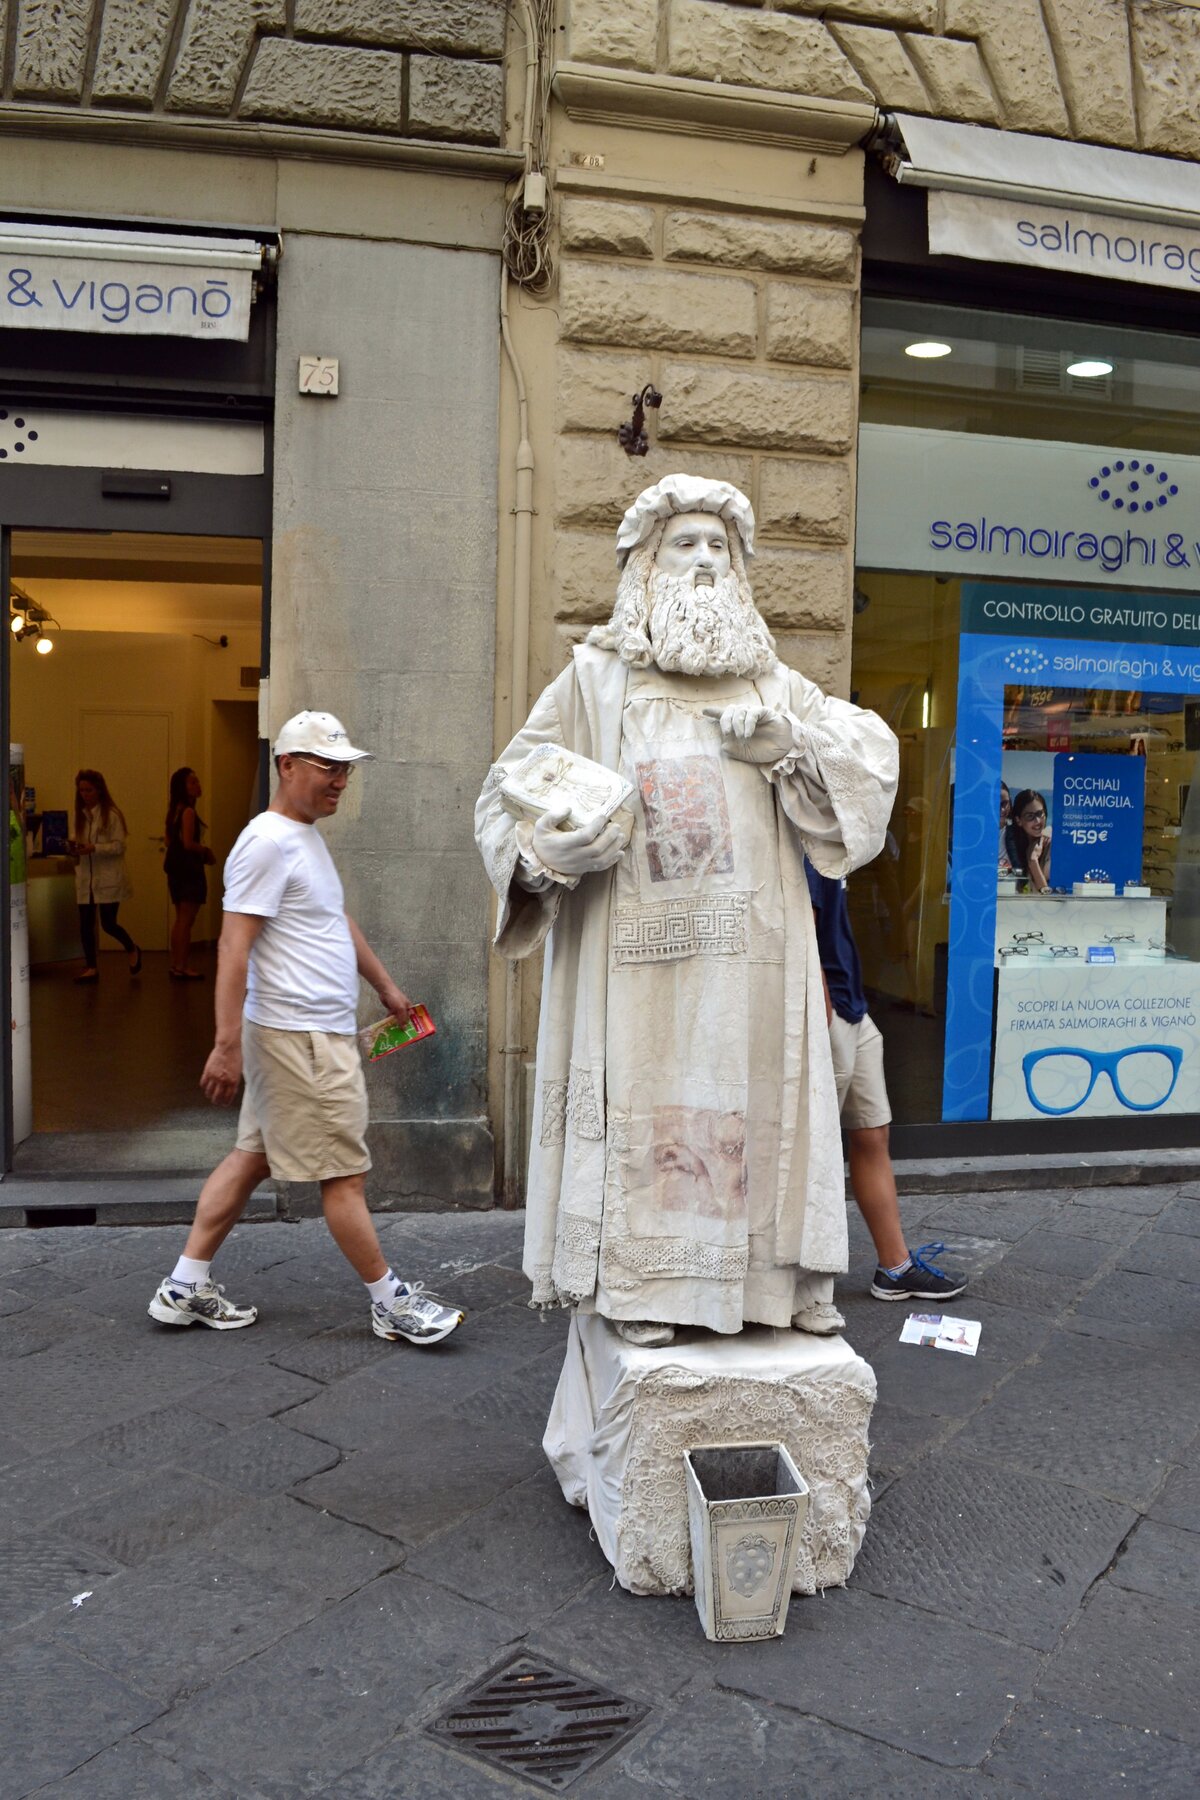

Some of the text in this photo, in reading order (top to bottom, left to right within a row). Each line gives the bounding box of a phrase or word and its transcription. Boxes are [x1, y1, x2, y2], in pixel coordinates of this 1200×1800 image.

[7, 268, 43, 308] &
[303, 363, 335, 388] 75
[930, 517, 1156, 573] salmoiraghi
[1163, 533, 1191, 569] &
[983, 600, 1200, 631] CONTROLLO GRATUITO DEL
[1053, 655, 1158, 679] salmoiraghi
[1162, 660, 1175, 677] &
[1063, 776, 1121, 791] OCCHIALI
[1063, 794, 1135, 809] DI FAMIGLIA.
[1070, 829, 1108, 845] 159€
[1017, 997, 1191, 1013] SCOPRI LA NUOVA COLLEZIONE
[1010, 1011, 1197, 1031] FIRMATA SALMOIRAGHI & VIGANÒ
[434, 1718, 504, 1730] COMUNE
